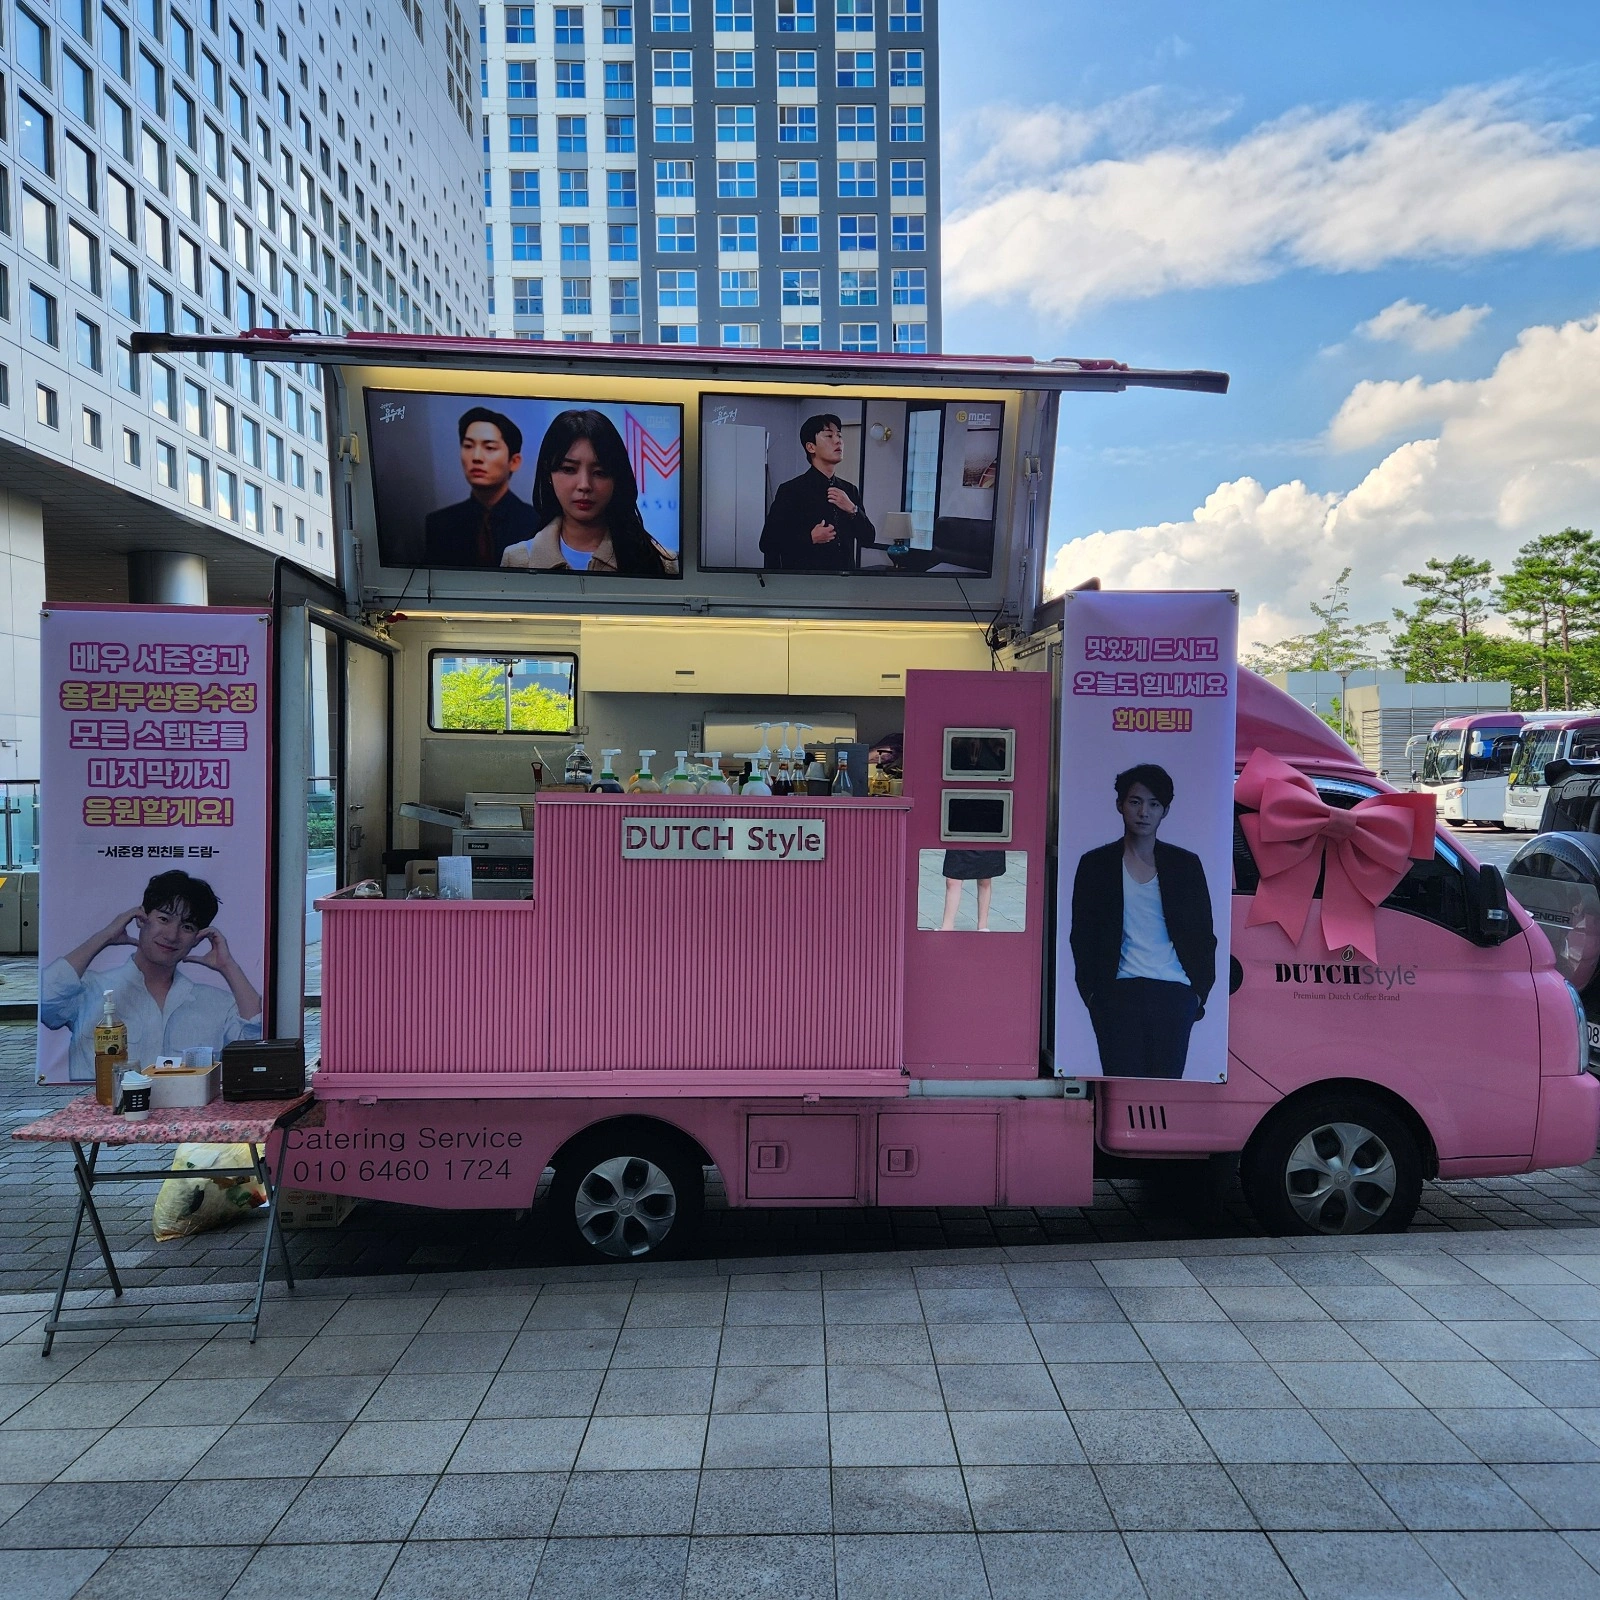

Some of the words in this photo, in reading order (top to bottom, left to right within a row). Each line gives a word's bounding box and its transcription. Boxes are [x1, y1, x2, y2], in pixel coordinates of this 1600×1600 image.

[70, 642, 129, 673] 배우
[133, 644, 249, 675] 서준영과
[1085, 636, 1149, 661] 맛있게
[1151, 637, 1218, 661] 드시고
[60, 680, 257, 713] 용감무쌍용수정
[1073, 671, 1139, 696] 오늘도
[1140, 672, 1228, 697] 힘내세요
[1112, 707, 1192, 732] 화이팅!!
[70, 720, 129, 750] 모든
[133, 721, 248, 751] 스탭분들
[88, 758, 230, 788] 마지막까지
[83, 796, 234, 827] 응원할게요!
[147, 846, 185, 858] 찐친들
[626, 825, 734, 850] DUTCH
[747, 826, 821, 859] Style
[1532, 910, 1571, 924] ENDER
[1293, 991, 1326, 1000] Premium
[1328, 992, 1351, 1001] Dutch
[1353, 992, 1377, 1001] Coffee
[1378, 993, 1400, 1002] Brand
[286, 1127, 405, 1152] Catering
[418, 1127, 523, 1149] Service
[293, 1160, 346, 1182] 010
[359, 1159, 429, 1182] 6460
[444, 1158, 512, 1181] 1724
